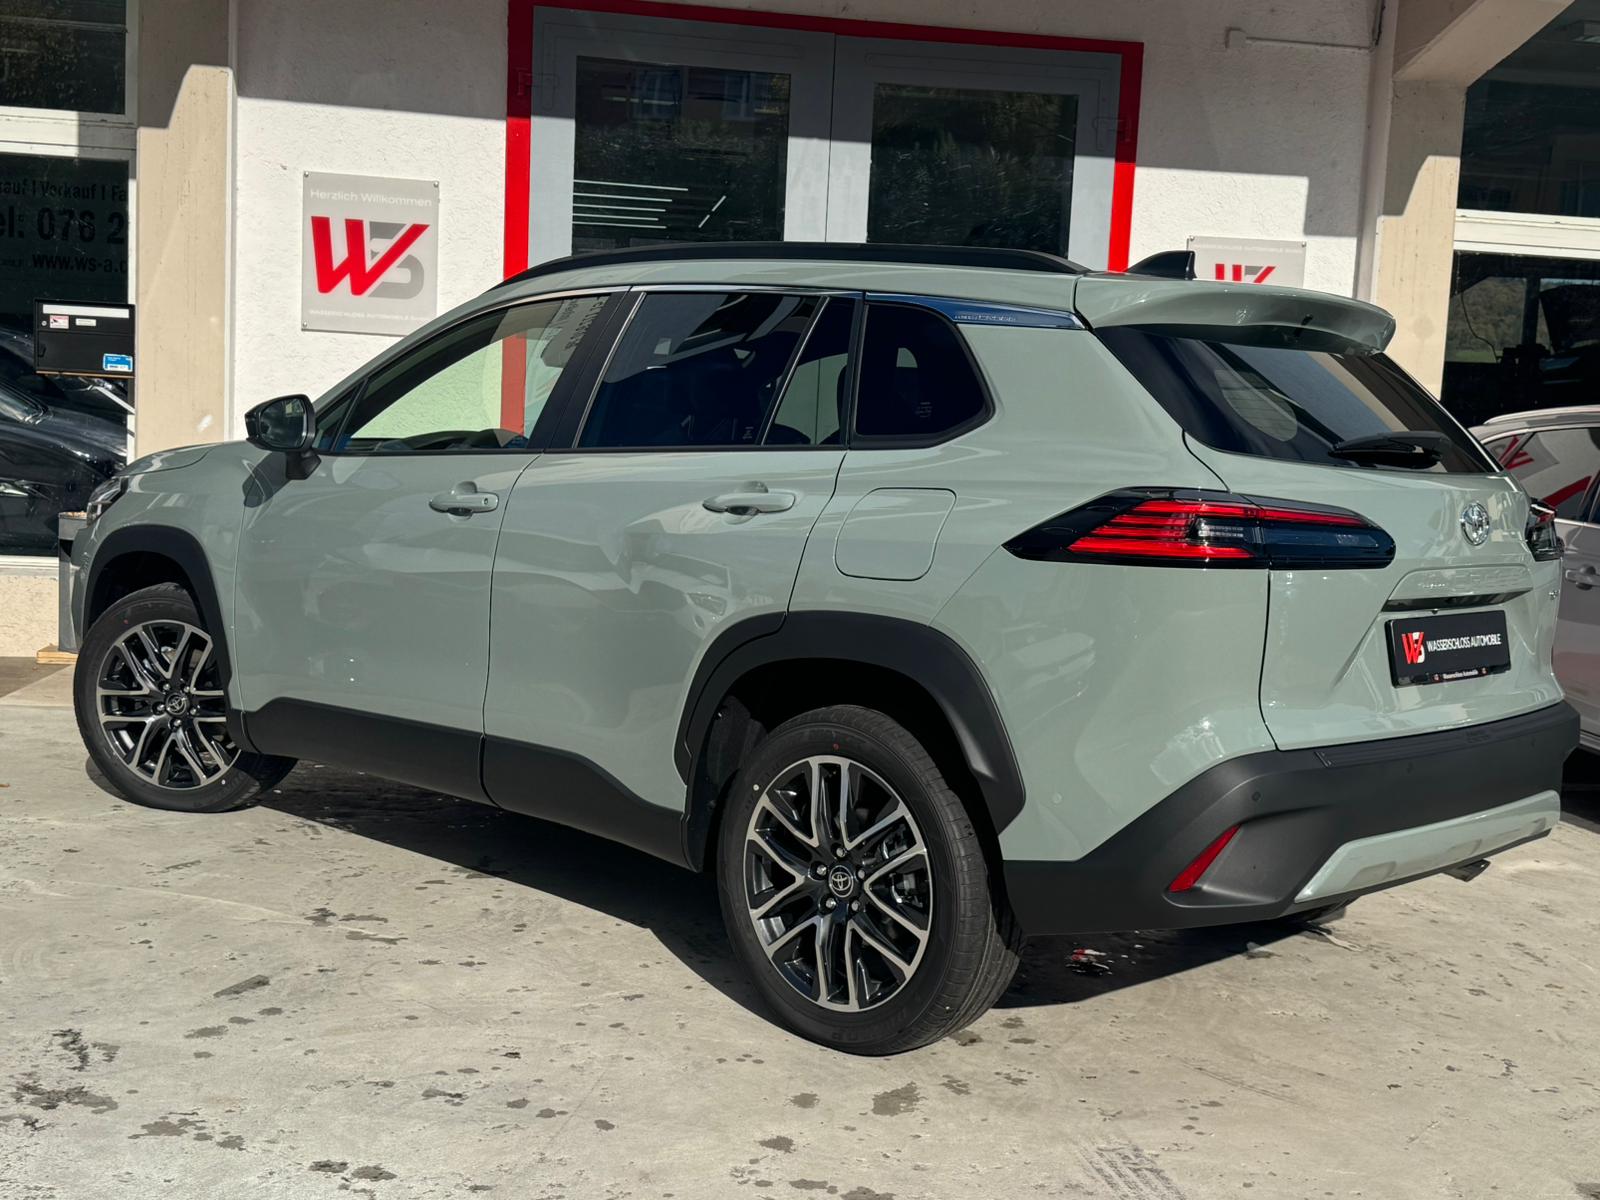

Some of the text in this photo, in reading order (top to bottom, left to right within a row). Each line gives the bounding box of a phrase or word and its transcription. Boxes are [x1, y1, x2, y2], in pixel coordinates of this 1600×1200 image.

[0, 178, 28, 195] auf
[310, 189, 432, 207] Herzlich Willkommen
[37, 207, 96, 243] 076
[106, 211, 125, 244] 2
